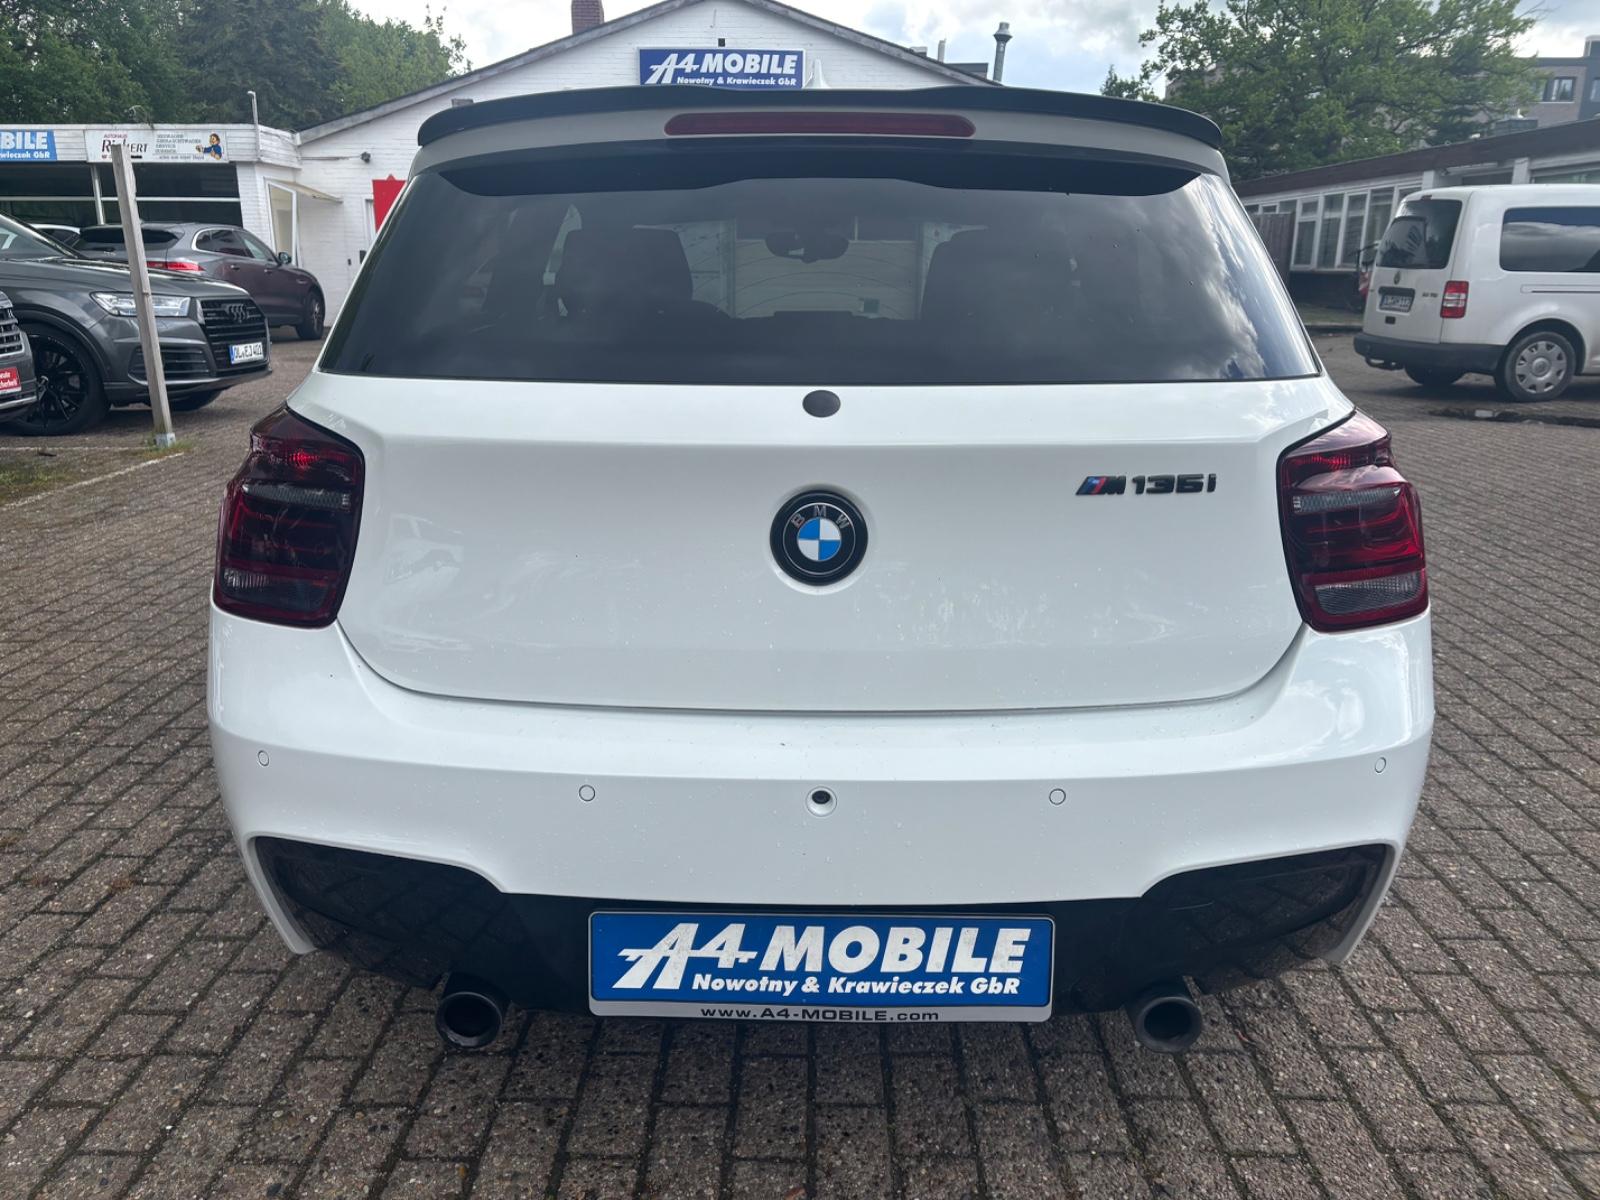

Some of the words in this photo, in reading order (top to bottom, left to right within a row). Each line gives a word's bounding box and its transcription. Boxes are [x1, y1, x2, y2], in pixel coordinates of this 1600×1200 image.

[727, 77, 776, 85] Krawieczek
[778, 77, 797, 86] GbR
[791, 504, 850, 529] BMW
[692, 974, 798, 996] Nowotny
[801, 976, 820, 993] &
[828, 976, 964, 994] Krawieczek
[970, 977, 1021, 995] GbR
[700, 1007, 940, 1022] www.A4-MOBILE.com
